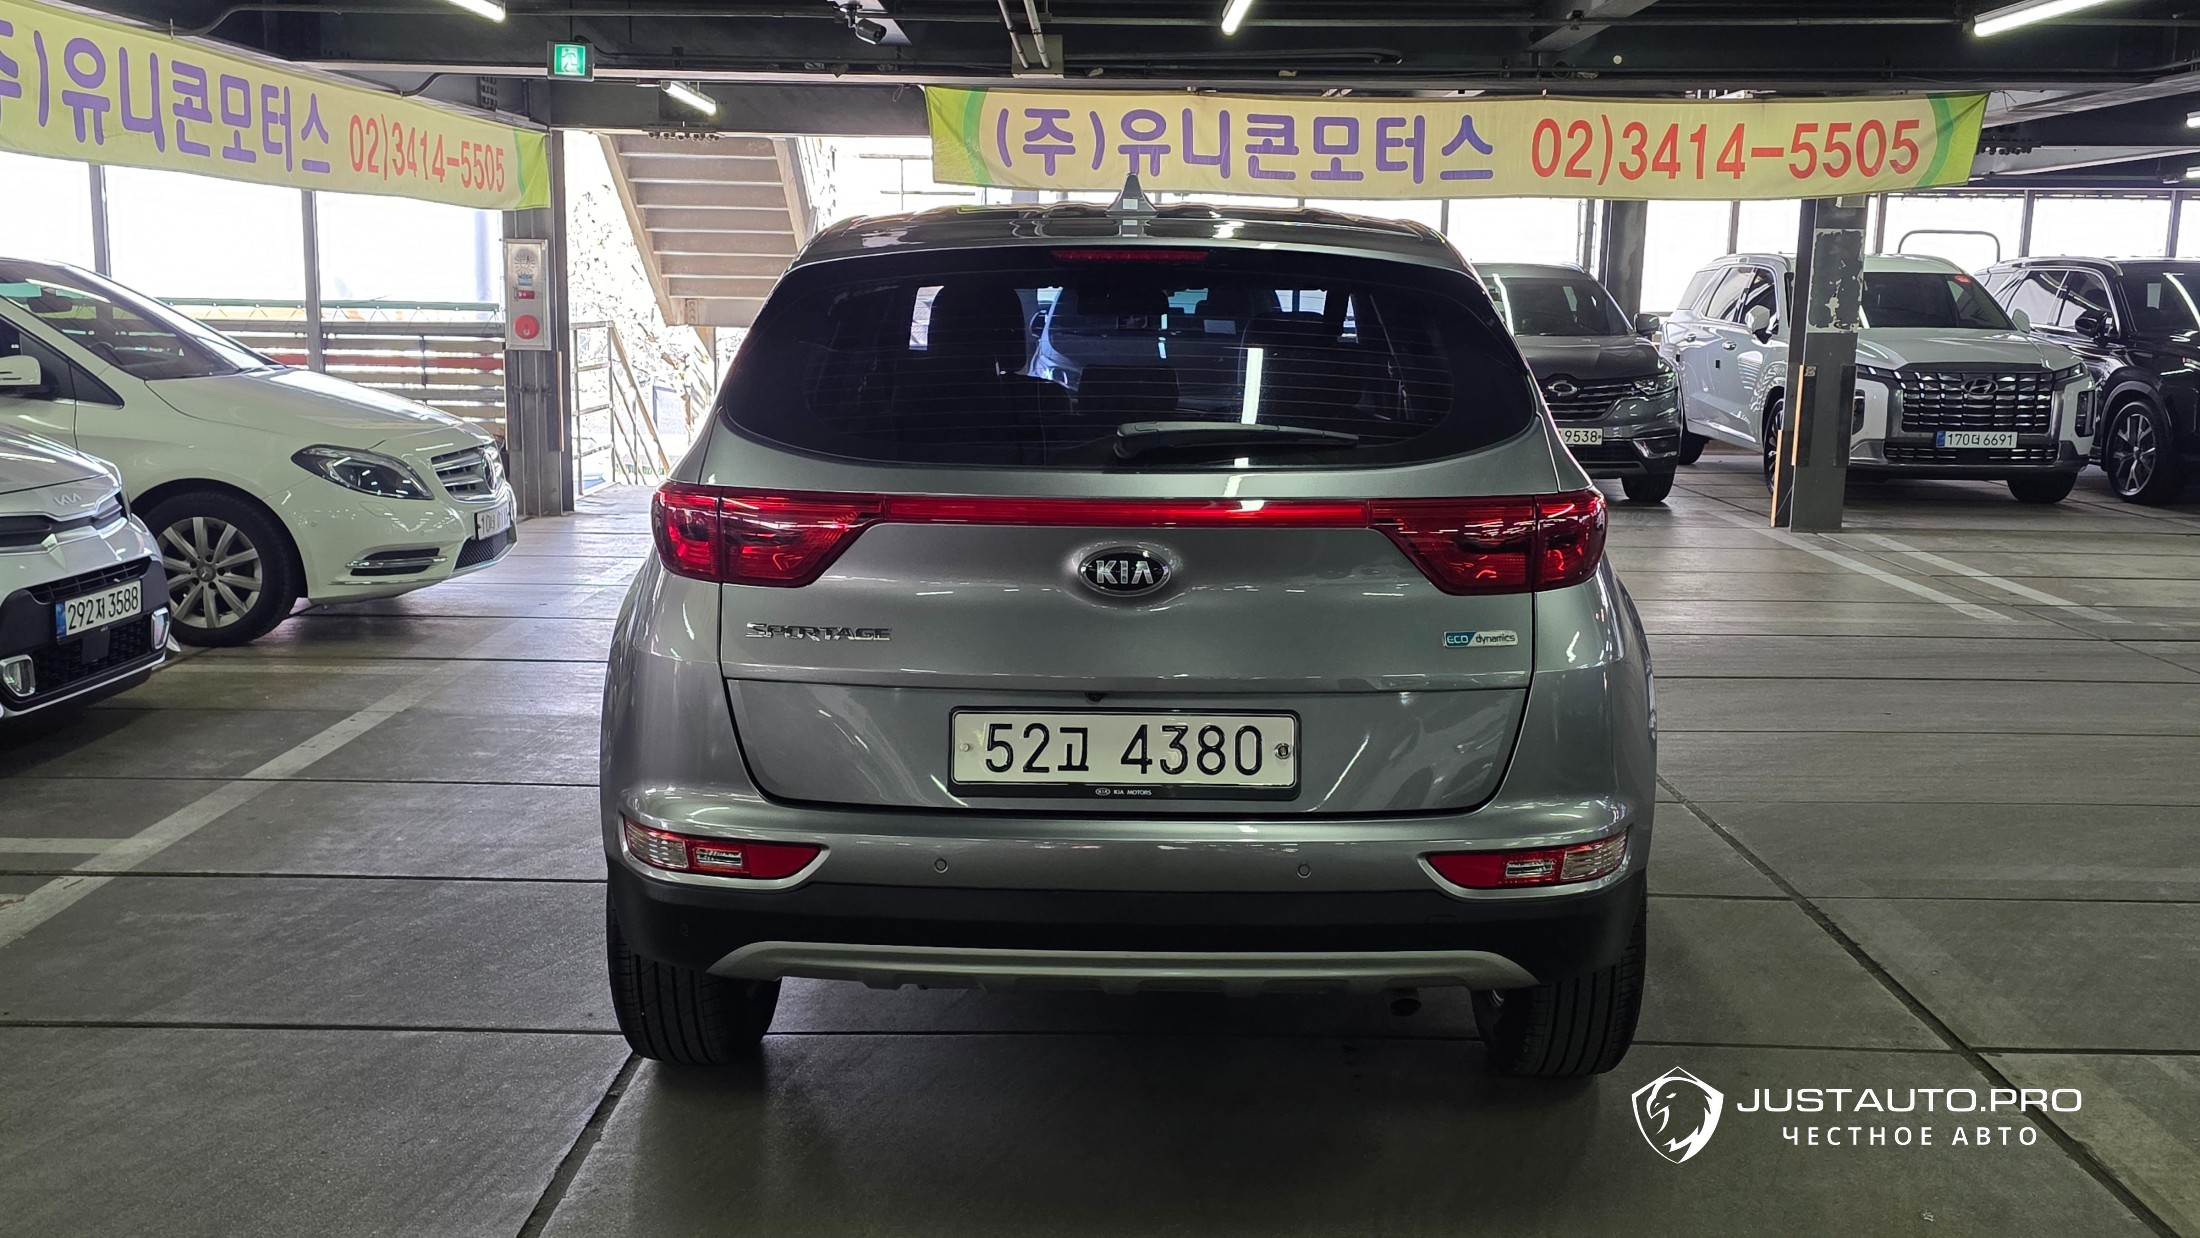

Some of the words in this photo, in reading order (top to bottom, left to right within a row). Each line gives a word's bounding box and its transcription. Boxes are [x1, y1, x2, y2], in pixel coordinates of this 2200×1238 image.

[349, 113, 506, 193] 02)3414-5505
[996, 107, 1494, 185] (주)유니콘모터스
[1531, 114, 1921, 186] 02)3414-5505
[1564, 430, 1598, 443] 9538
[1096, 560, 1154, 584] KIA
[108, 586, 139, 618] 3588
[745, 622, 892, 642] SPORTAGE
[1446, 635, 1469, 644] ECO
[1475, 633, 1516, 645] dynamics
[985, 723, 1090, 774] 52고
[1120, 724, 1263, 776] 4380
